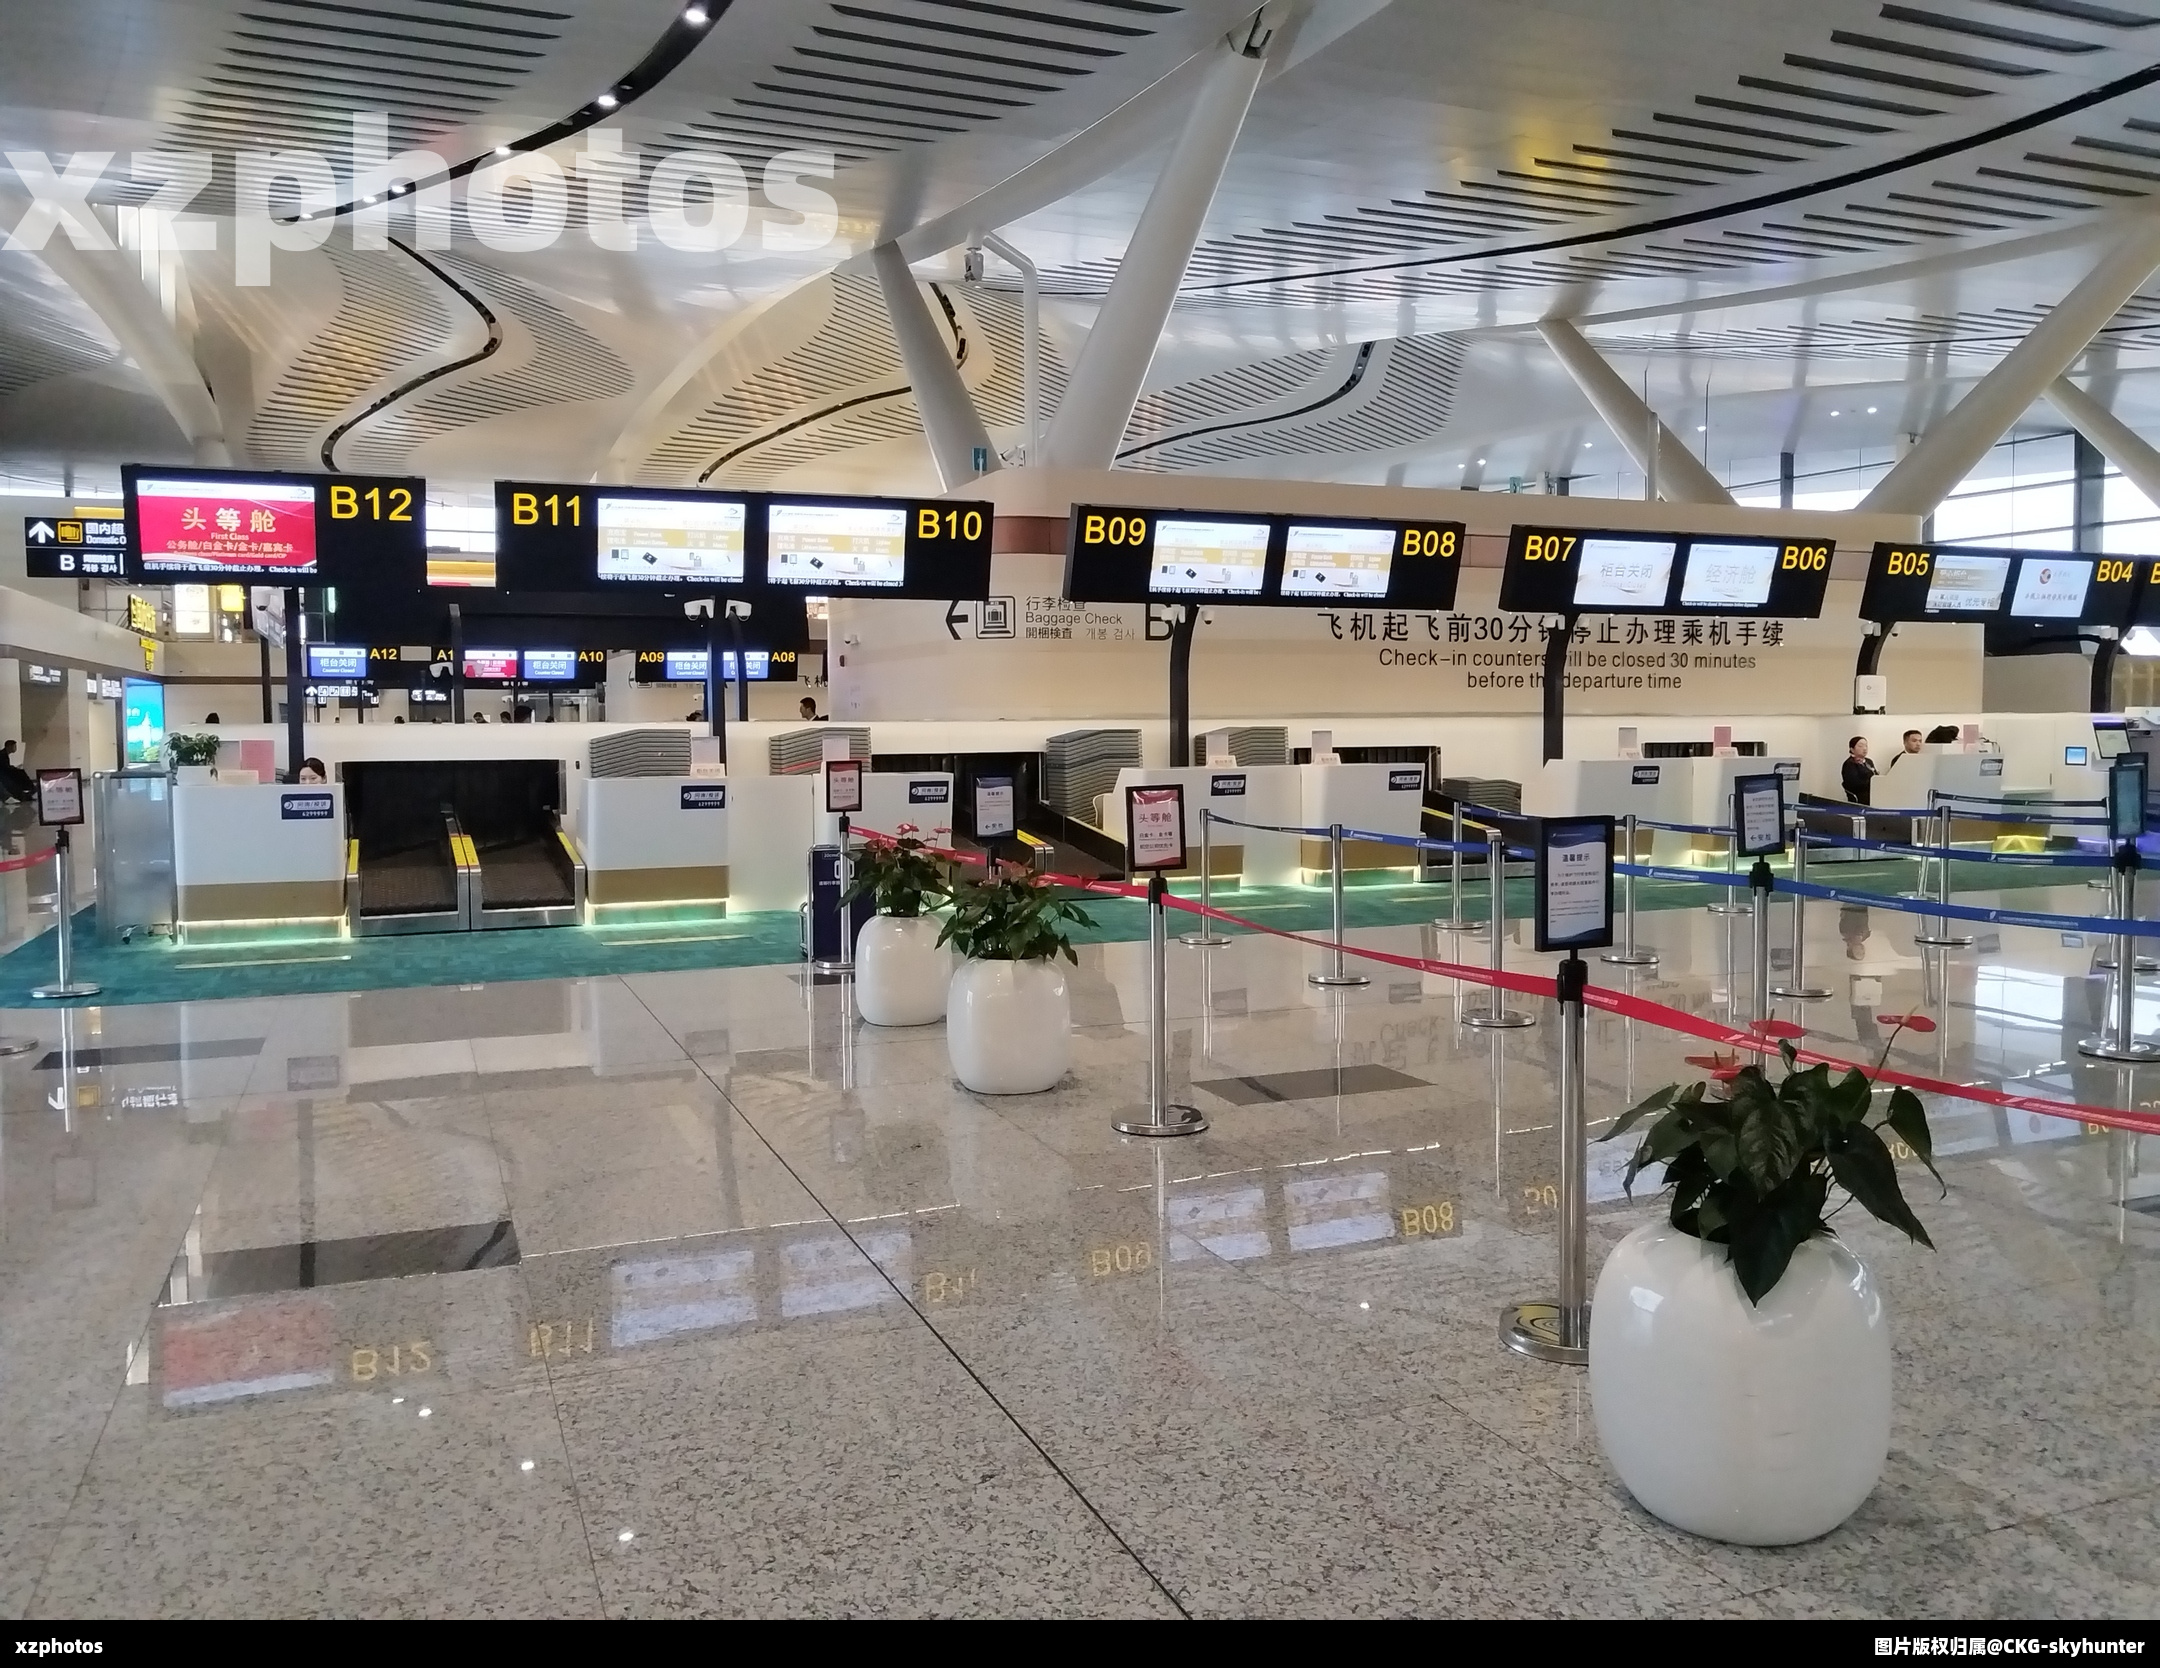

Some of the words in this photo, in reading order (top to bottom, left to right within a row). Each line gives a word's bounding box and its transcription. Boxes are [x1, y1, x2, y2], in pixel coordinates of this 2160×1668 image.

[330, 485, 412, 522] B12
[513, 493, 580, 526] B11
[181, 507, 276, 532] 头等舱
[918, 510, 982, 541] B10
[211, 532, 228, 540] First
[230, 532, 249, 541] Class
[1084, 515, 1146, 546] B09
[86, 535, 119, 544] Domestic
[1402, 529, 1456, 558] B08
[1524, 535, 1576, 562] B07
[60, 554, 76, 571] B
[1781, 545, 1828, 571] B06
[1887, 551, 1929, 576] B05
[1600, 562, 1653, 578] 柜台关闭
[1705, 564, 1756, 584] 经济舱
[2096, 560, 2133, 582] B04
[1026, 612, 1080, 626] Baggage
[1085, 612, 1122, 624] Check
[1145, 602, 1174, 641] B
[370, 648, 398, 660] A12
[437, 649, 454, 660] A1
[578, 651, 604, 662] A10
[639, 652, 664, 662] A09
[771, 652, 796, 662] A08
[1473, 651, 1547, 667] counters
[1587, 652, 1607, 668] be
[1612, 652, 1666, 668] closed
[1670, 652, 1688, 668] 30
[1694, 652, 1756, 668] minutes
[320, 658, 356, 668] 柜台关闭
[532, 660, 566, 670] 柜台关闭
[675, 662, 706, 670] 柜台关闭
[1468, 672, 1524, 688] before
[1562, 672, 1642, 692] departure
[1647, 673, 1682, 688] time
[1138, 812, 1172, 824] 头等舱
